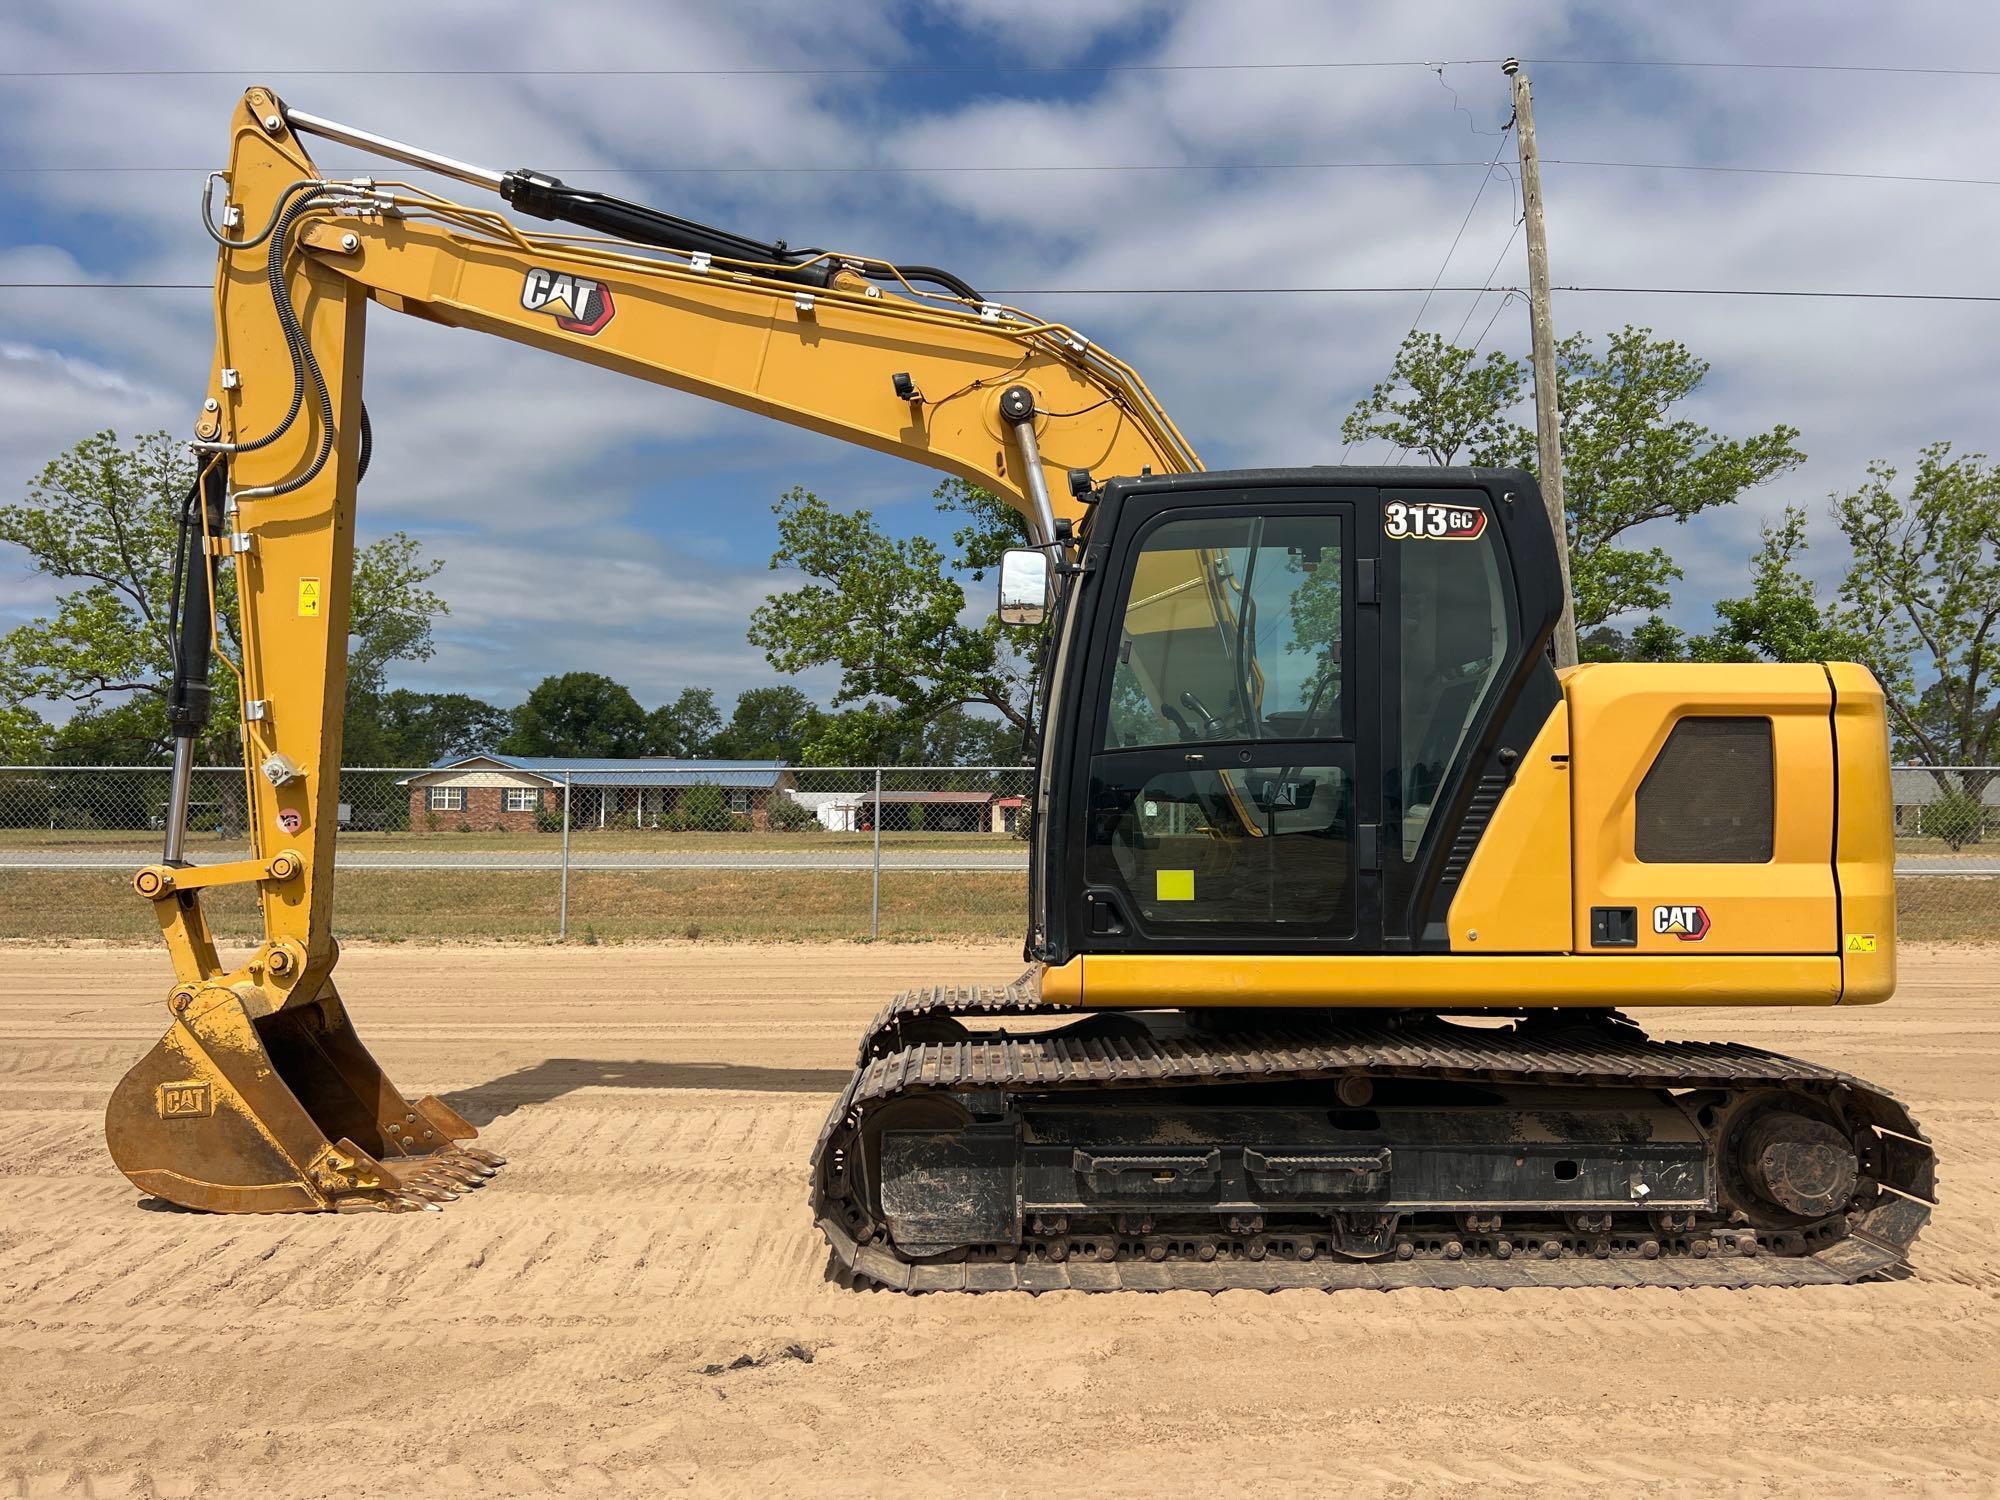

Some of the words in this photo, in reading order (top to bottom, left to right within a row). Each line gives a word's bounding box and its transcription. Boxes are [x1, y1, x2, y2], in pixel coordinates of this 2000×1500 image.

[522, 269, 598, 321] CAT
[1387, 502, 1447, 535] 313
[1450, 511, 1473, 528] GC
[1654, 906, 1697, 933] CAT
[167, 1088, 205, 1113] CAT
